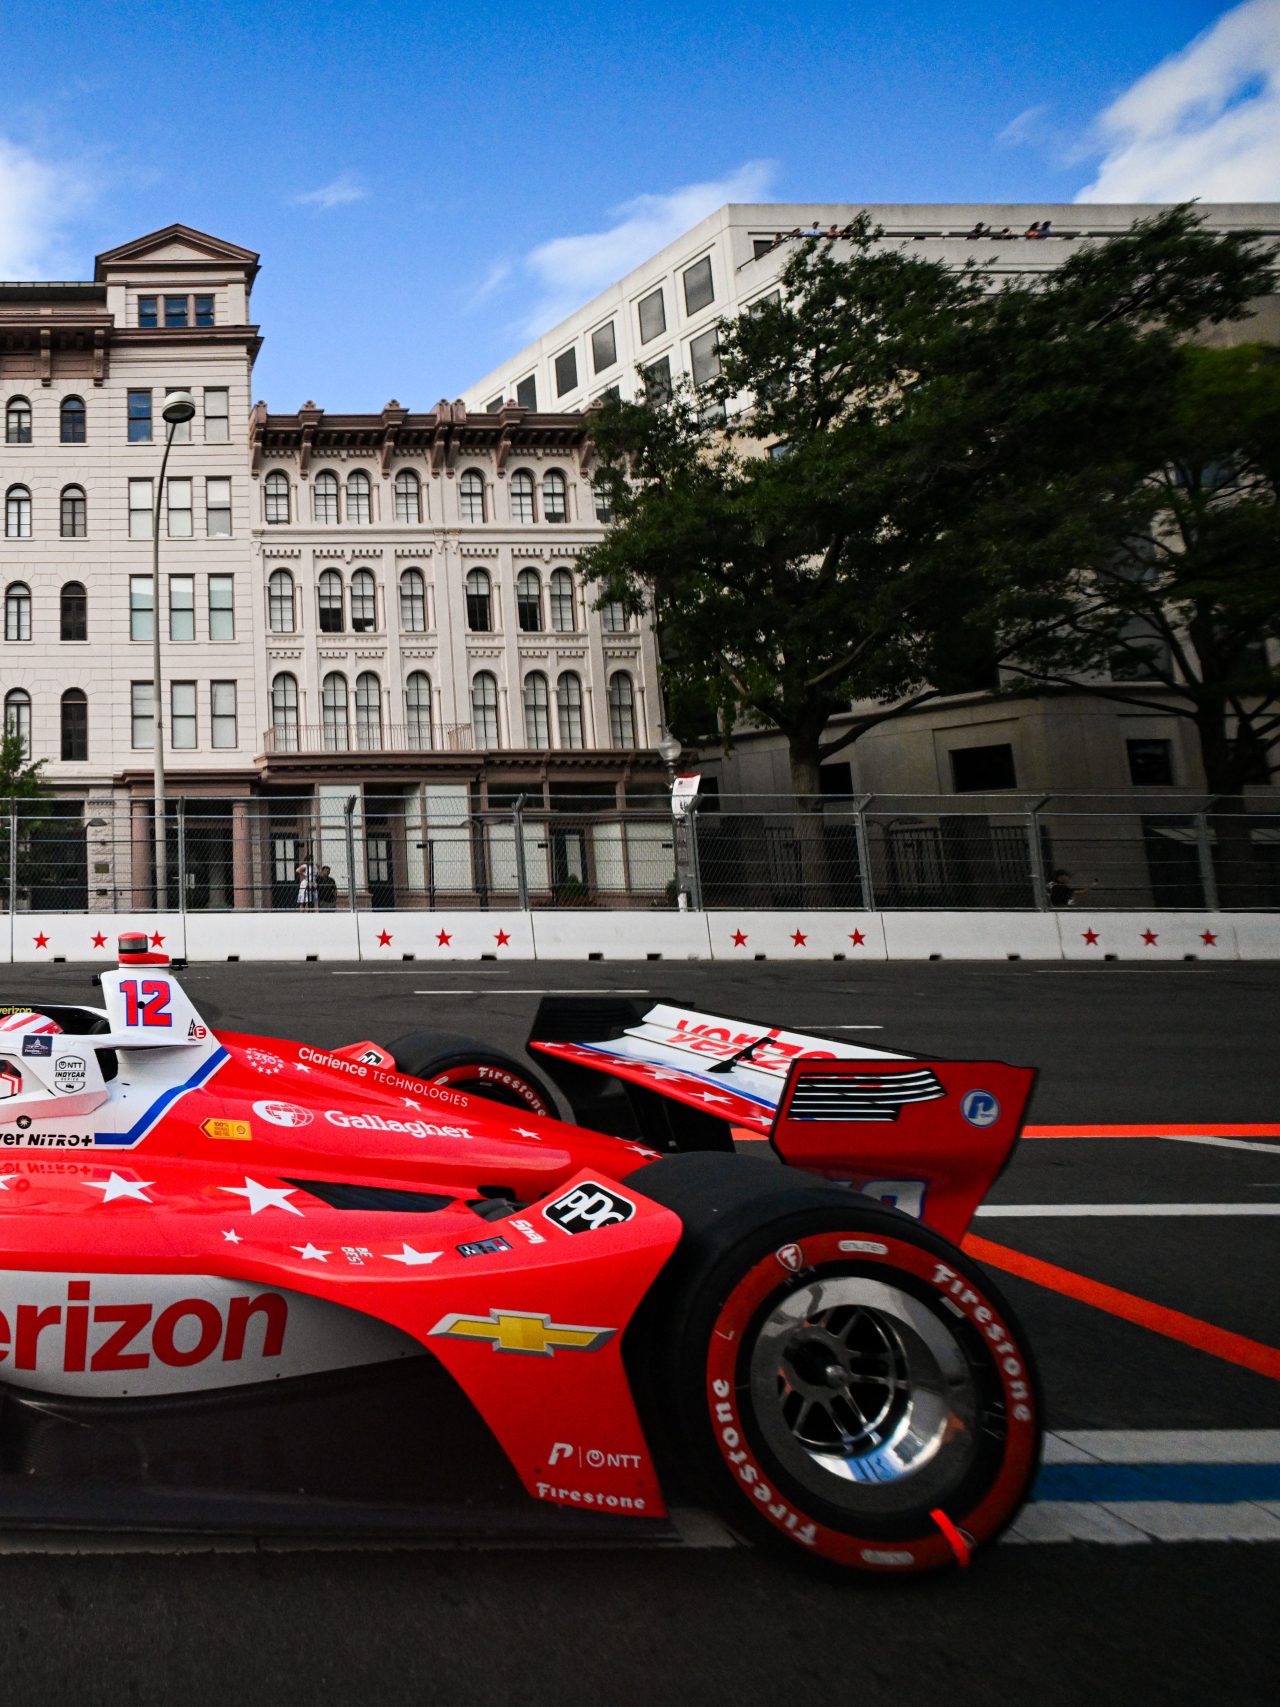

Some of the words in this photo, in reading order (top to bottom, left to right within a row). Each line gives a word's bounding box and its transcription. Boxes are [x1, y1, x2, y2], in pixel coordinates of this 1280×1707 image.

[119, 979, 173, 1028] 12
[298, 1047, 368, 1077] Clarience
[373, 1070, 469, 1108] TECHNOLOGIES
[478, 1066, 546, 1117] Firestone
[324, 1110, 474, 1139] Gallagher
[932, 1263, 1032, 1422] Firestone
[607, 1453, 642, 1468] NTT
[713, 1379, 817, 1546] Firestone
[536, 1482, 646, 1510] Firestone
